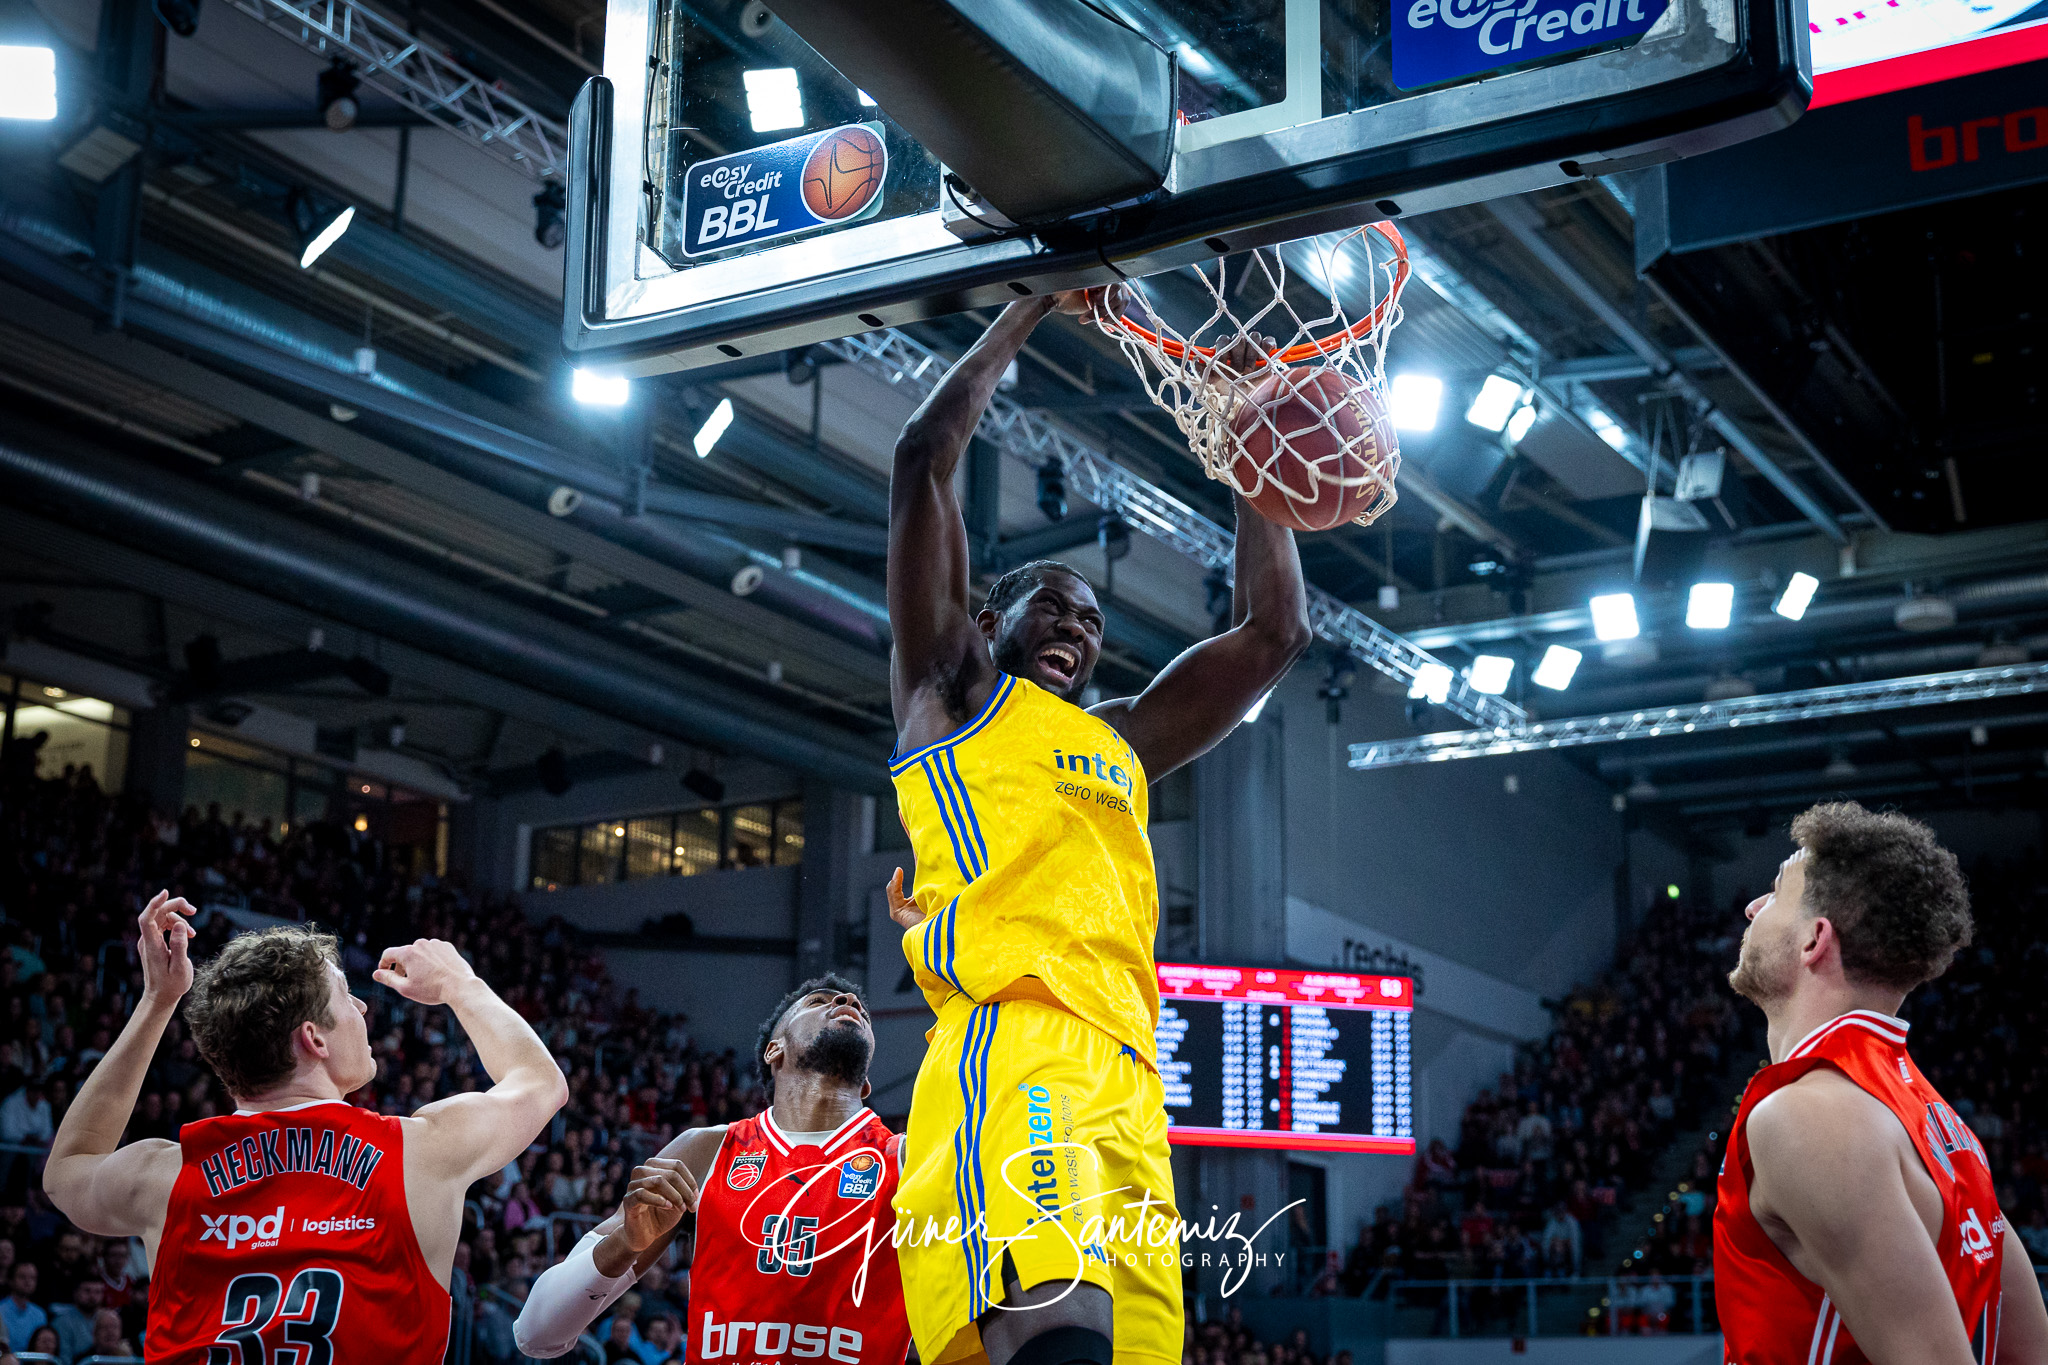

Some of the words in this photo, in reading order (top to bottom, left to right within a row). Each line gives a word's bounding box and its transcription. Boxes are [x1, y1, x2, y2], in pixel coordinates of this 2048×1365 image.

[724, 170, 783, 200] Credit
[697, 194, 780, 245] BBL
[1054, 781, 1091, 801] zero
[201, 1127, 384, 1197] HECKMANN
[842, 1183, 872, 1195] BBL
[199, 1205, 286, 1250] xpd
[302, 1215, 375, 1235] logistics
[251, 1238, 279, 1250] global
[756, 1214, 819, 1278] 35
[206, 1267, 344, 1365] 33
[701, 1310, 863, 1365] brose
